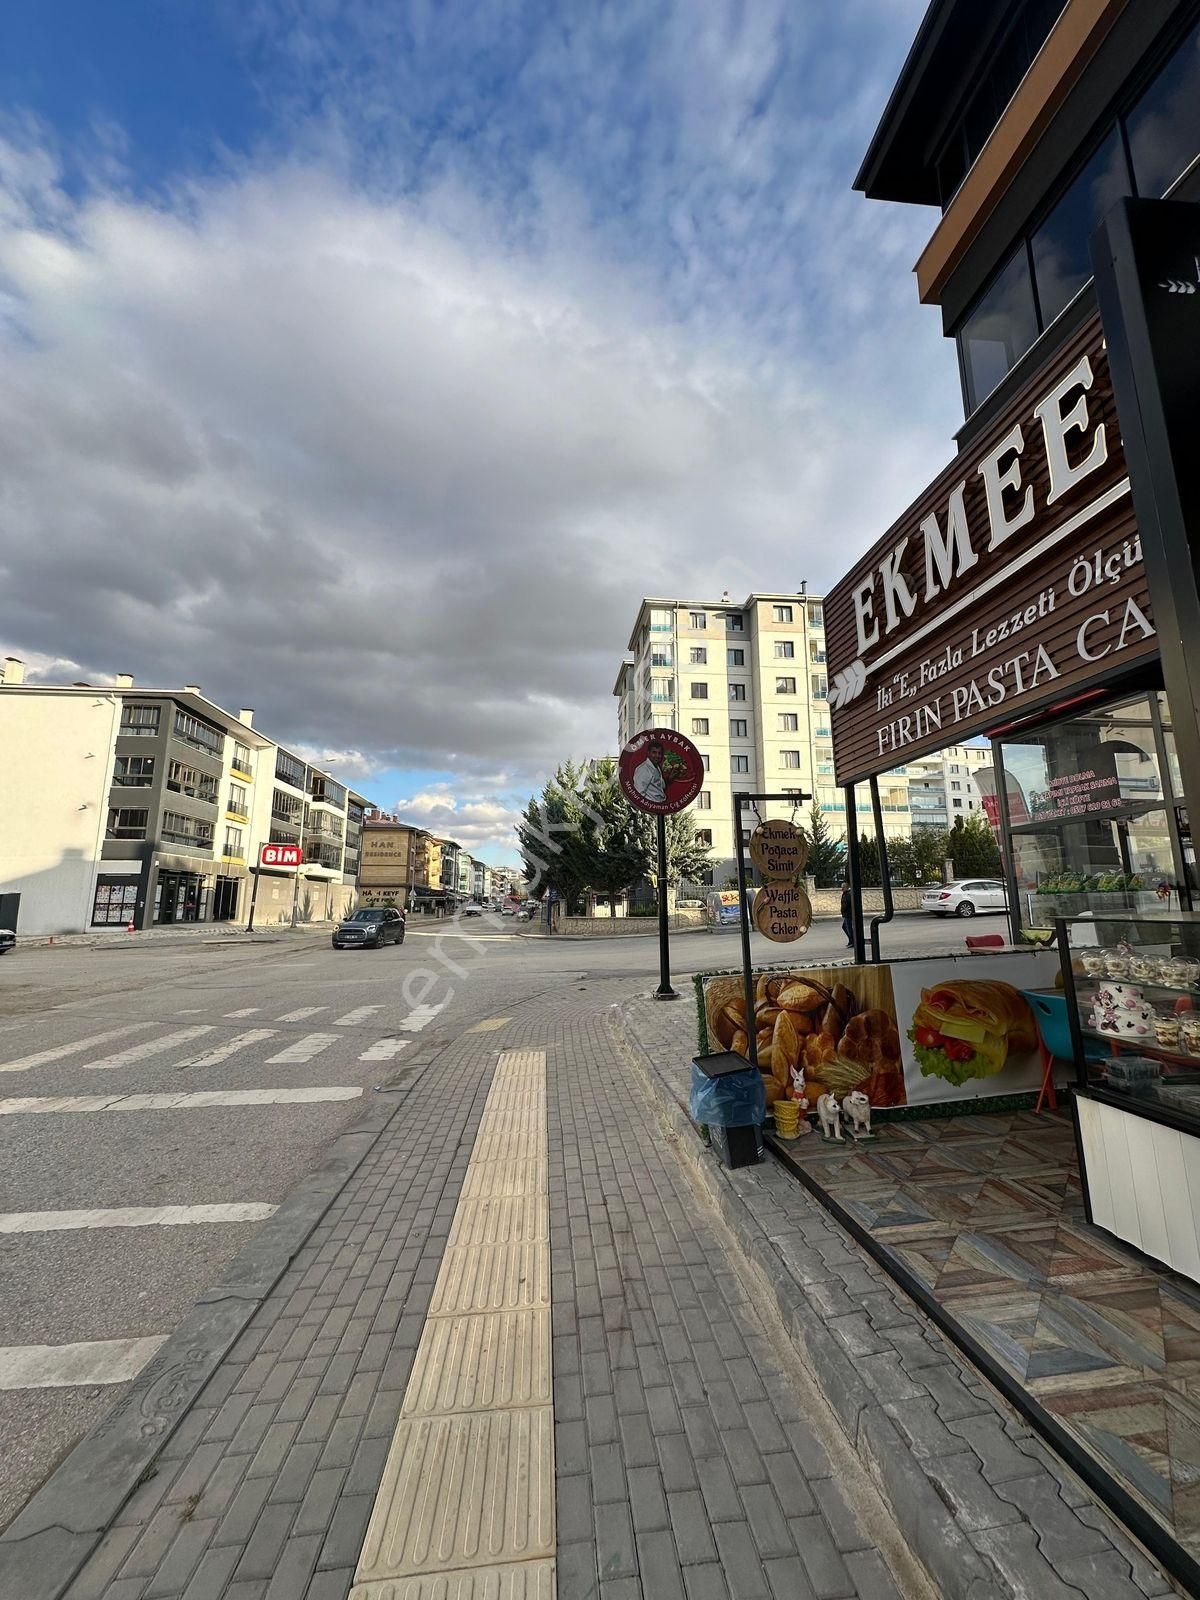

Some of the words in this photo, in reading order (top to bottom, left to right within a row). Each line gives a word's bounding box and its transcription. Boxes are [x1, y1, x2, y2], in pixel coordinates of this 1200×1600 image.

[852, 354, 1110, 657] EKMEE
[877, 685, 893, 711] İki
[919, 645, 963, 687] Fazla
[971, 587, 1056, 658] Lezzeti
[876, 697, 942, 756] FIRIN
[951, 643, 1061, 723] PASTA
[660, 733, 691, 752] AYBAK
[762, 827, 796, 840] Ekmek
[371, 841, 394, 849] HAN
[767, 859, 794, 871] Simit
[764, 889, 800, 904] Waffle
[769, 905, 798, 918] Pasta
[771, 922, 798, 935] Ekler
